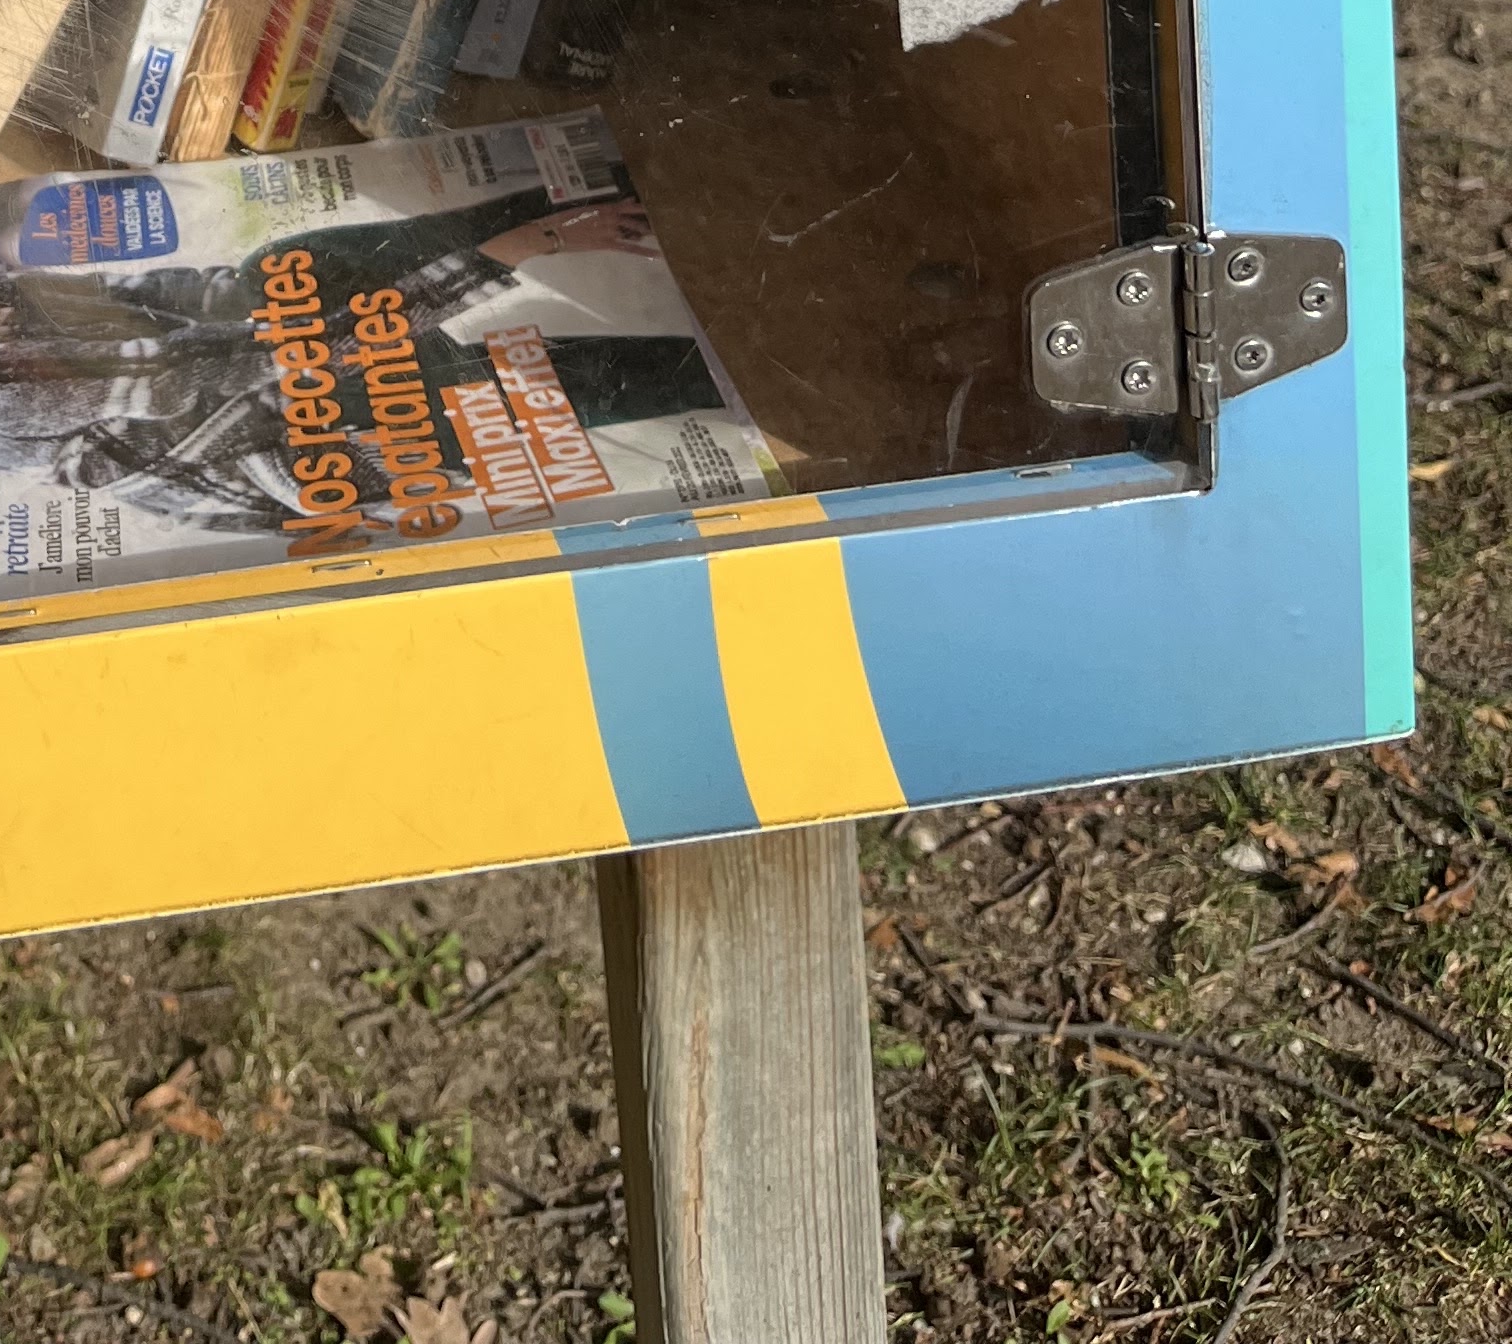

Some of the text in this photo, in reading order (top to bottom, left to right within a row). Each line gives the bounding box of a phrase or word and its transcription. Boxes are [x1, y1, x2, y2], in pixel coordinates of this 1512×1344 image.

[133, 49, 170, 127] POCKET
[32, 213, 57, 239] Les
[120, 187, 143, 251] VALIDÉES PAR
[145, 190, 167, 244] LA SCIENCE
[251, 248, 371, 557] Nos recettes
[342, 287, 484, 539] épatantes
[495, 325, 610, 494] Maxi effet
[443, 380, 548, 529] Mini prix
[67, 488, 98, 583] mon pouvoir
